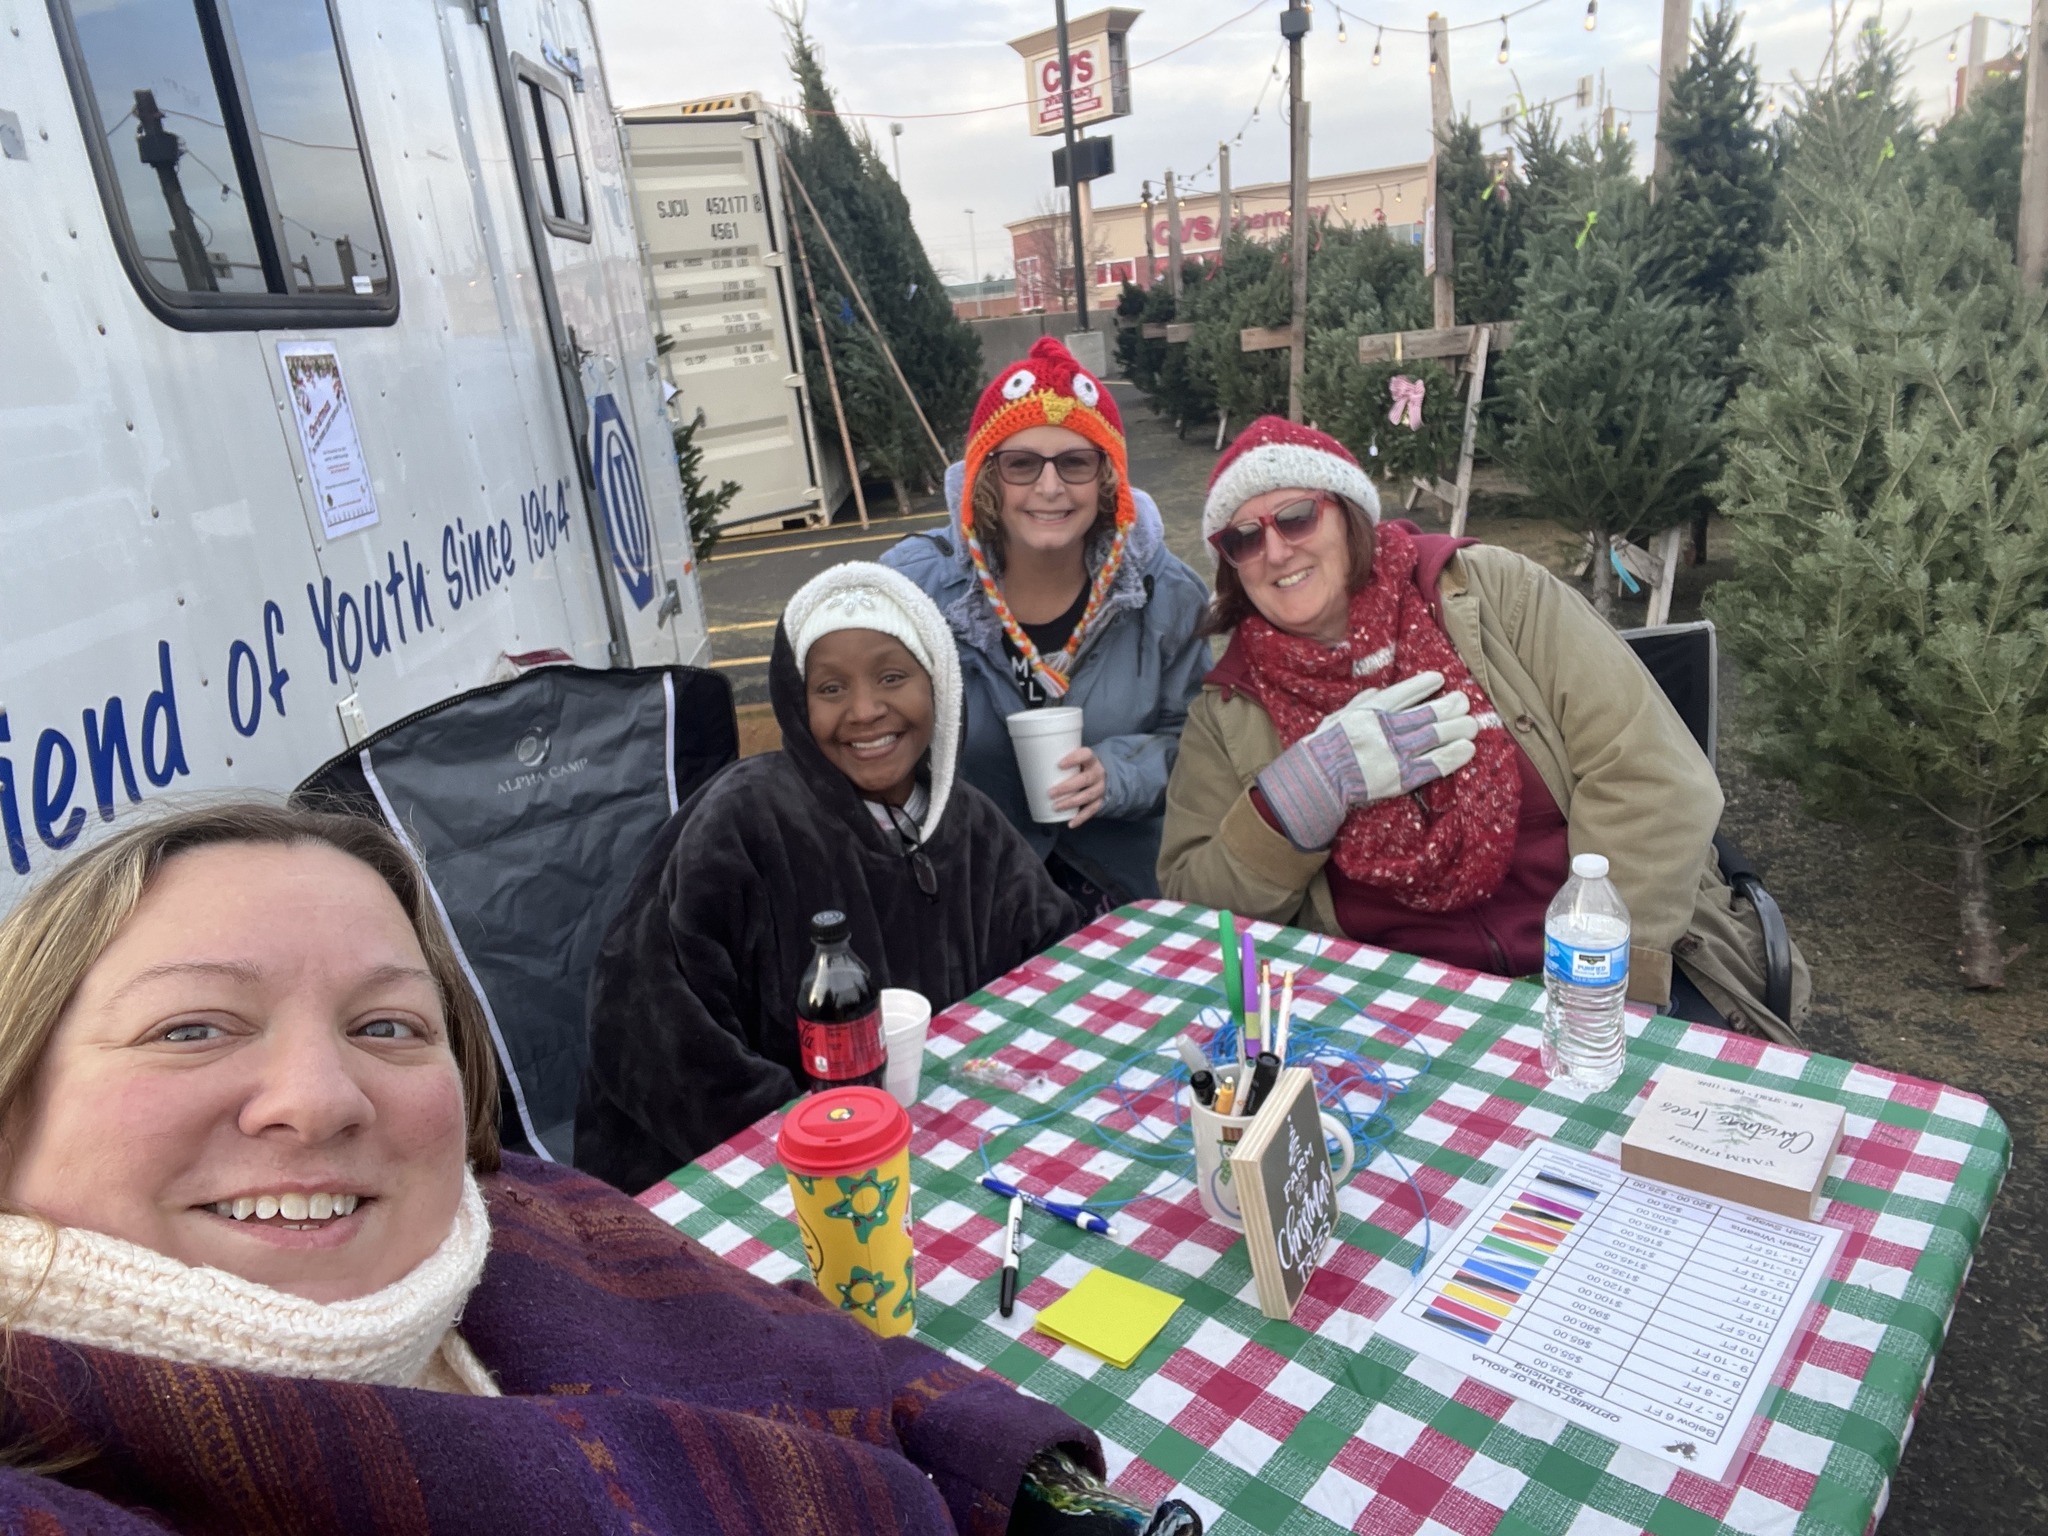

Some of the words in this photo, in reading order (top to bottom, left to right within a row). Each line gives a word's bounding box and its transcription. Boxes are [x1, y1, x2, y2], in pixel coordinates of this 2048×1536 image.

[657, 199, 689, 218] SJCU
[706, 196, 748, 215] 452177
[711, 222, 739, 240] 45G1
[228, 600, 290, 737] of
[307, 540, 434, 685] Youth
[442, 517, 515, 610] Since
[497, 771, 545, 795] ALPHA
[548, 757, 588, 779] CAMP
[1659, 1101, 1708, 1133] Trees
[1717, 1114, 1814, 1154] Christmas
[1666, 1134, 1720, 1157] FRESH
[1725, 1153, 1775, 1167] FARM
[1283, 1142, 1314, 1202] FARM
[1632, 1179, 1670, 1196] $25.00
[1675, 1192, 1713, 1209] $20.00
[1277, 1160, 1333, 1270] Christmas
[1745, 1213, 1785, 1231] Swags
[1730, 1223, 1775, 1243] Wreaths
[1784, 1225, 1817, 1241] Fresh
[1298, 1214, 1332, 1283] TREES
[1744, 1242, 1763, 1252] FT
[1778, 1238, 1811, 1253] Fresh
[1764, 1248, 1778, 1257] 15
[1741, 1255, 1759, 1265] FT
[1789, 1255, 1803, 1264] 14
[1594, 1261, 1640, 1282] $135.00
[1731, 1266, 1749, 1276] FT
[1750, 1271, 1764, 1281] 13
[1782, 1267, 1796, 1277] 13
[1586, 1273, 1631, 1295] $120.00
[1739, 1283, 1758, 1294] FT
[1775, 1279, 1790, 1289] 12
[1577, 1286, 1623, 1308] $100.00
[1731, 1296, 1751, 1306] FT
[1759, 1289, 1783, 1302] 11.5
[1571, 1300, 1611, 1320] $90.00
[1752, 1302, 1776, 1315] 11.5
[1561, 1314, 1602, 1334] $80.00
[1735, 1313, 1754, 1323] FT
[1756, 1319, 1769, 1329] 11
[1715, 1322, 1735, 1333] FT
[1552, 1328, 1593, 1349] $65.00
[1736, 1328, 1761, 1343] 10.5
[1718, 1340, 1738, 1351] FT
[1739, 1346, 1754, 1357] 10
[1542, 1342, 1583, 1364] $55.00
[1691, 1347, 1711, 1359] FT
[1712, 1354, 1727, 1365] 10
[1471, 1352, 1511, 1375] ROLLA
[1532, 1357, 1574, 1379] $35.00
[1739, 1364, 1749, 1373] 9
[1509, 1369, 1530, 1382] OF
[1513, 1360, 1557, 1385] Pricing
[1690, 1365, 1710, 1377] FT
[1711, 1372, 1721, 1381] 9
[1528, 1377, 1564, 1397] CLUB
[1555, 1379, 1587, 1397] 2023
[1681, 1380, 1702, 1393] FT
[1731, 1380, 1741, 1389] 8
[1703, 1388, 1713, 1397] 8
[1560, 1391, 1621, 1422] OPTIMIST
[1673, 1397, 1693, 1409] FT
[1722, 1396, 1732, 1405] 7
[1642, 1404, 1663, 1417] FT
[1694, 1405, 1704, 1414] 7
[1714, 1411, 1724, 1421] 6
[1664, 1412, 1674, 1421] 6
[1676, 1417, 1716, 1438] Below
